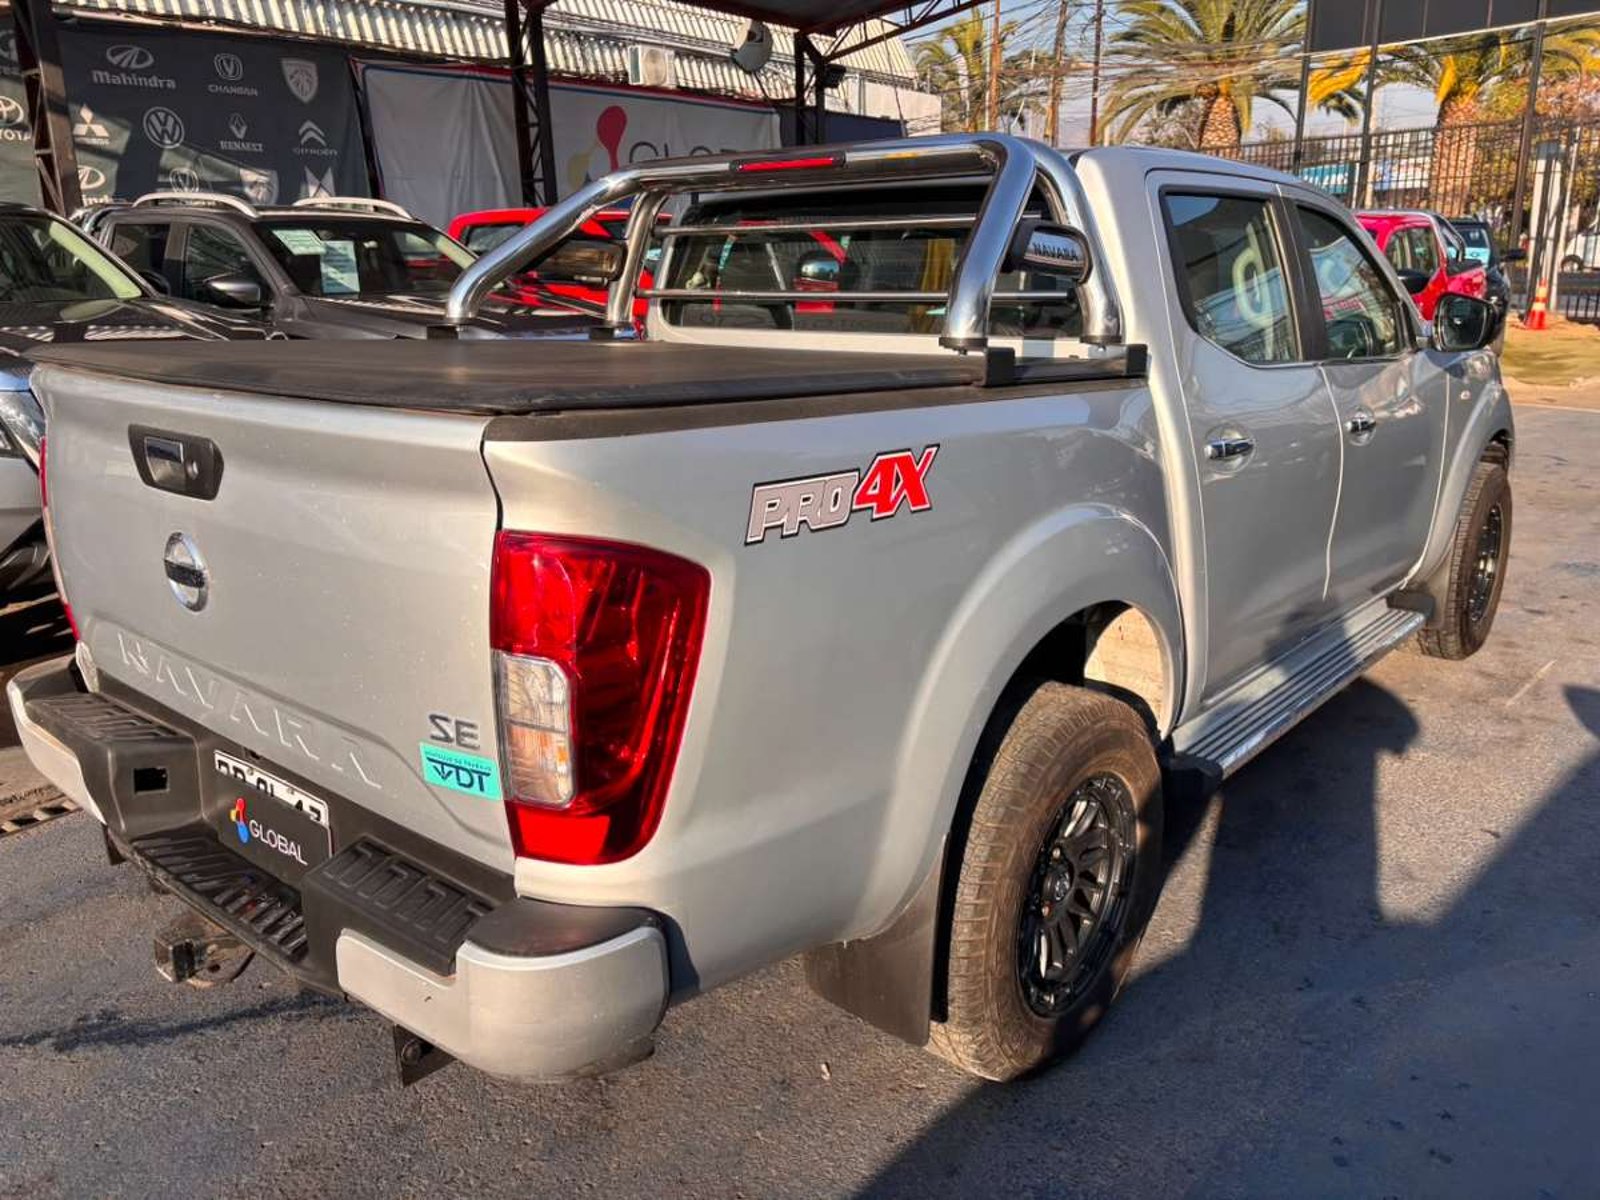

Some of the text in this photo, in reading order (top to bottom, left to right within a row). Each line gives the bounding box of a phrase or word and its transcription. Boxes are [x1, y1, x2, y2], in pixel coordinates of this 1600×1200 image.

[92, 70, 176, 90] Mahindra
[220, 140, 264, 152] RENAULT
[1032, 241, 1080, 261] NAVARA
[116, 631, 384, 791] NAVARA
[429, 714, 481, 751] SE
[248, 819, 309, 866] GLOBAL
